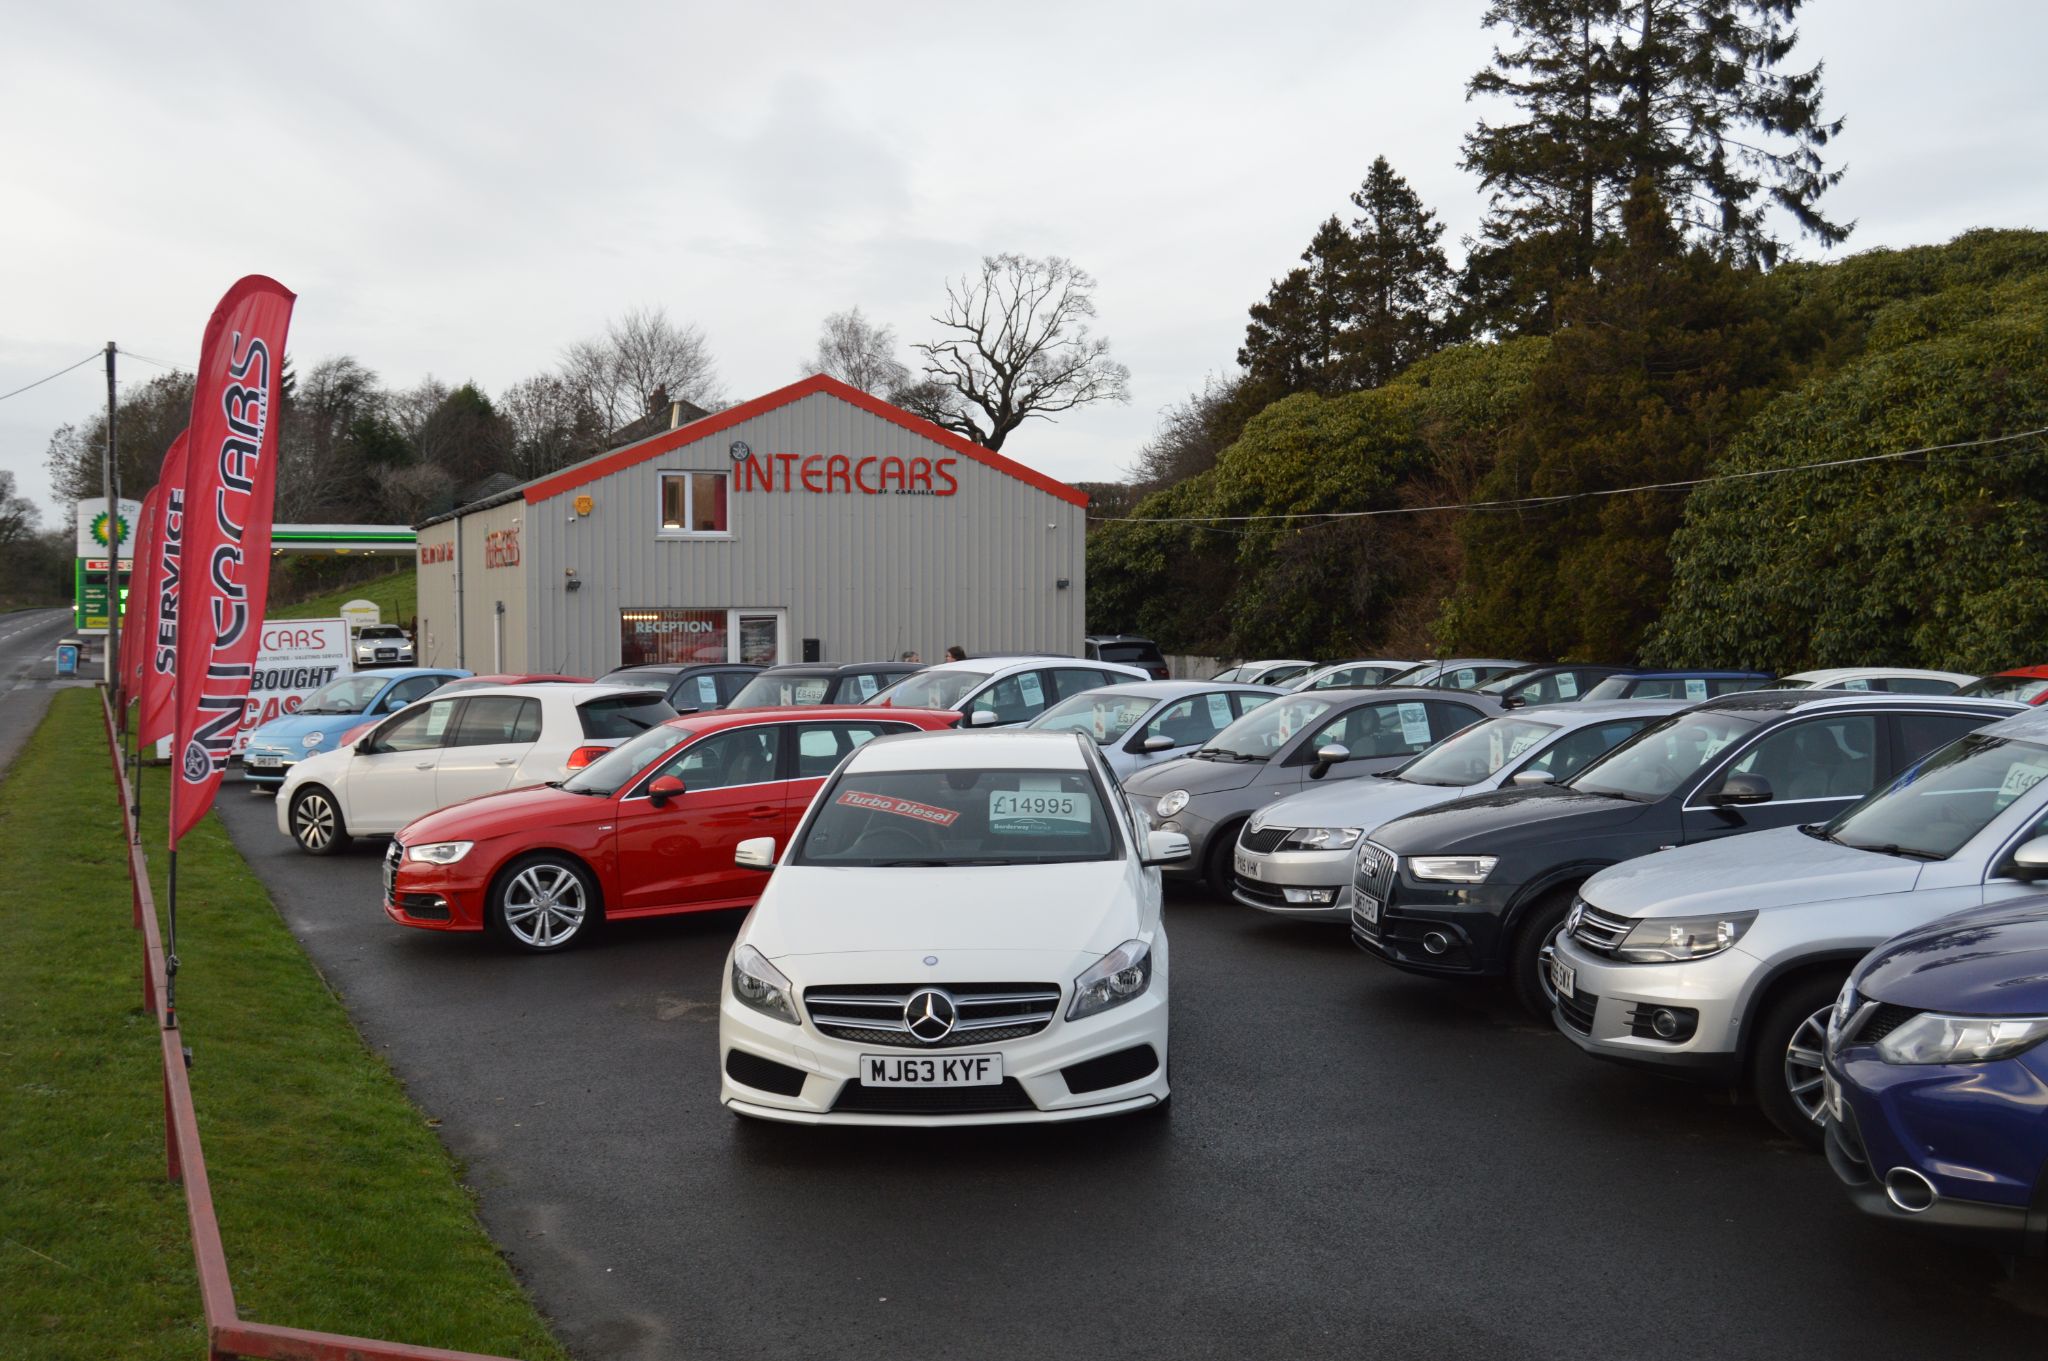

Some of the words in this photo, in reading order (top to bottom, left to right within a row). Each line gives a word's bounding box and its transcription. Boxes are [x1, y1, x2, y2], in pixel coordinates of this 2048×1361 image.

[734, 452, 958, 497] INTERCARS
[155, 487, 184, 676] SERVICE
[635, 621, 713, 633] RECEPTION
[263, 629, 326, 651] CARS
[252, 666, 337, 691] BOUGHT
[239, 695, 303, 731] CAS
[847, 791, 892, 809] Turbo
[895, 800, 951, 822] Diesel
[993, 795, 1073, 815] £14995
[871, 1059, 935, 1083] MJ63
[943, 1058, 991, 1082] KYF
